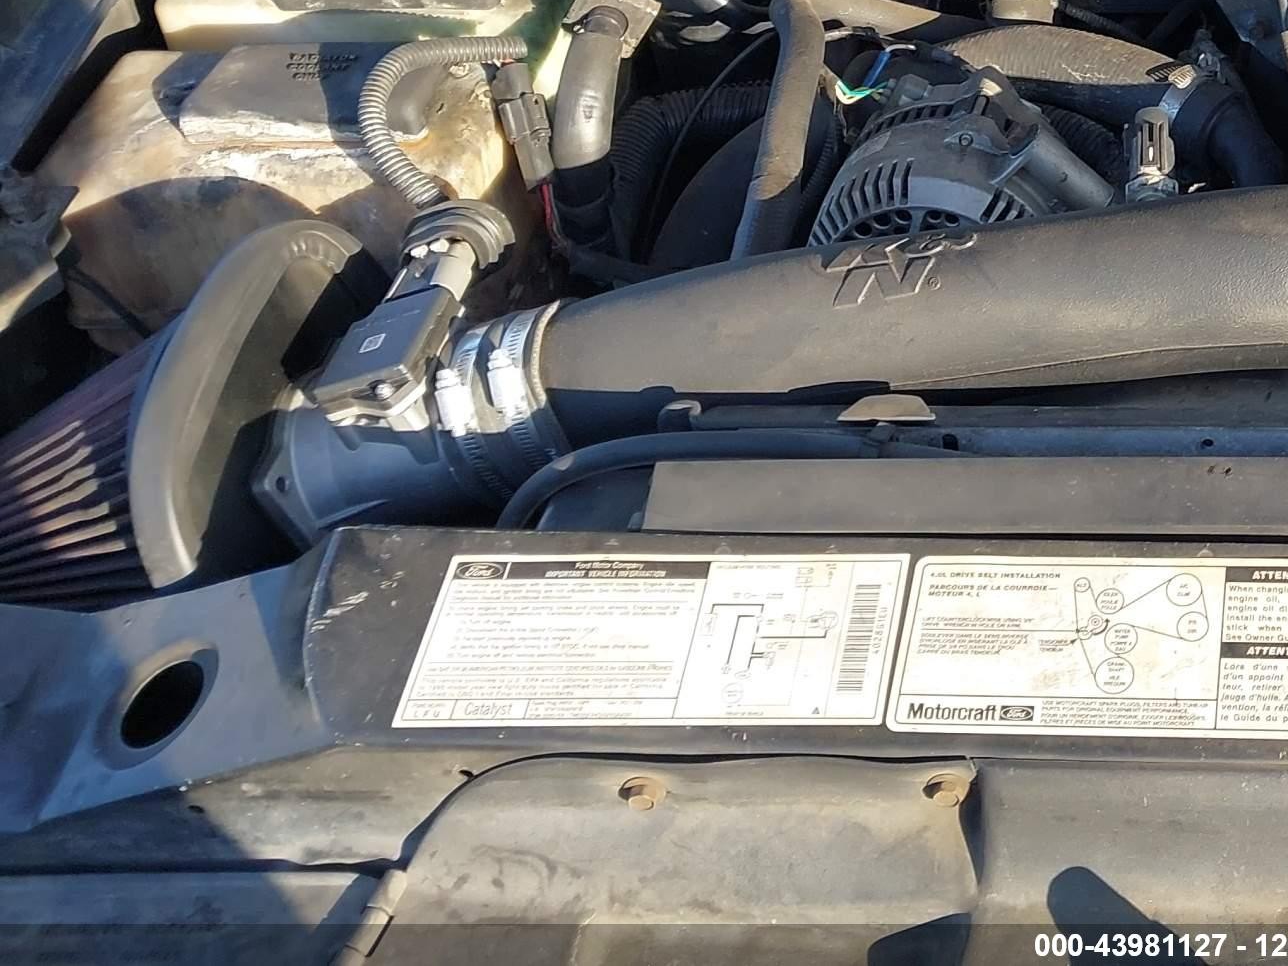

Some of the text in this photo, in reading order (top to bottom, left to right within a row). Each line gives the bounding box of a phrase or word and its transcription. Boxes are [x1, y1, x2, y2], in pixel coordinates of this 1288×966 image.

[1225, 633, 1242, 642] See
[1244, 633, 1274, 643] Owner
[463, 702, 512, 717] Catalyst
[906, 703, 996, 720] Motorcraft
